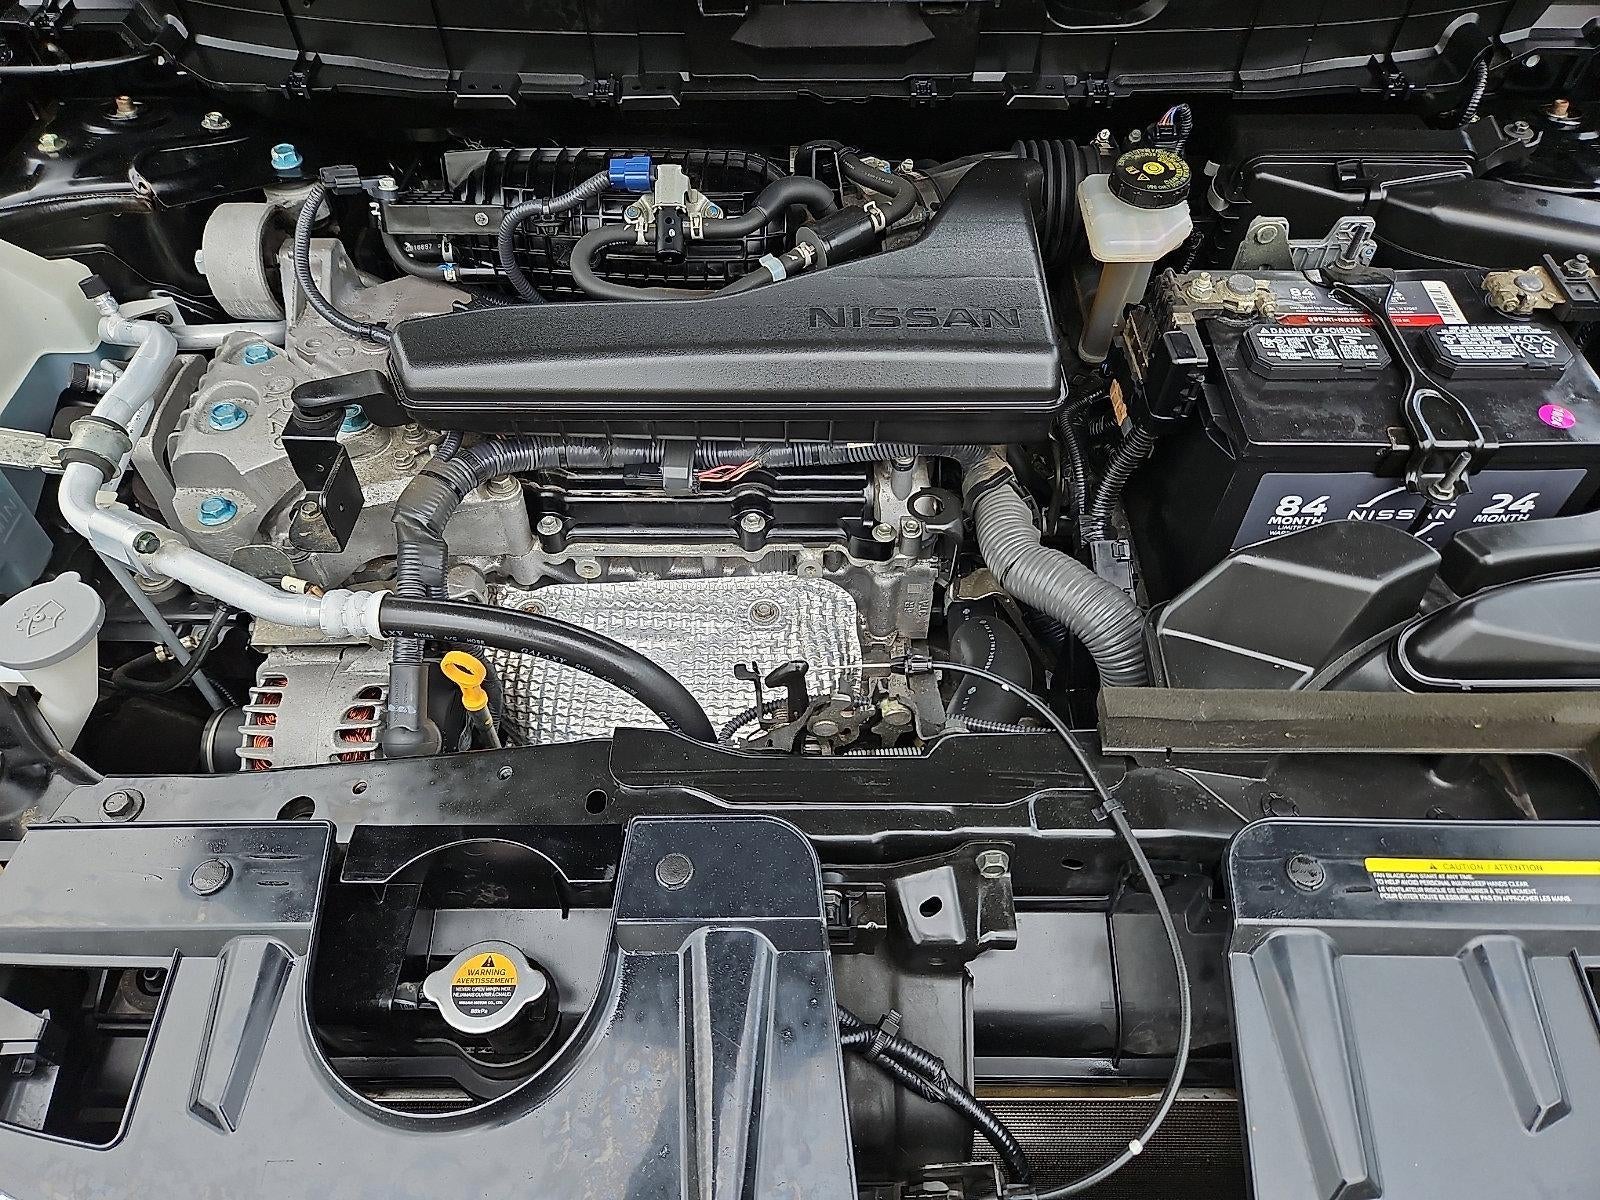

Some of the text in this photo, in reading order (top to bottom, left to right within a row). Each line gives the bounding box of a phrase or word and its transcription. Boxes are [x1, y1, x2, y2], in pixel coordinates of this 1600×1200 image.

[808, 306, 1022, 329] NISSAN
[1276, 496, 1330, 516] 84
[1482, 492, 1540, 514] 24
[1267, 516, 1324, 524] MONTH
[1348, 508, 1456, 520] NISSN
[1473, 514, 1530, 522] MONTH
[520, 648, 568, 664] GALAXY
[1494, 864, 1544, 872] ATTENTION
